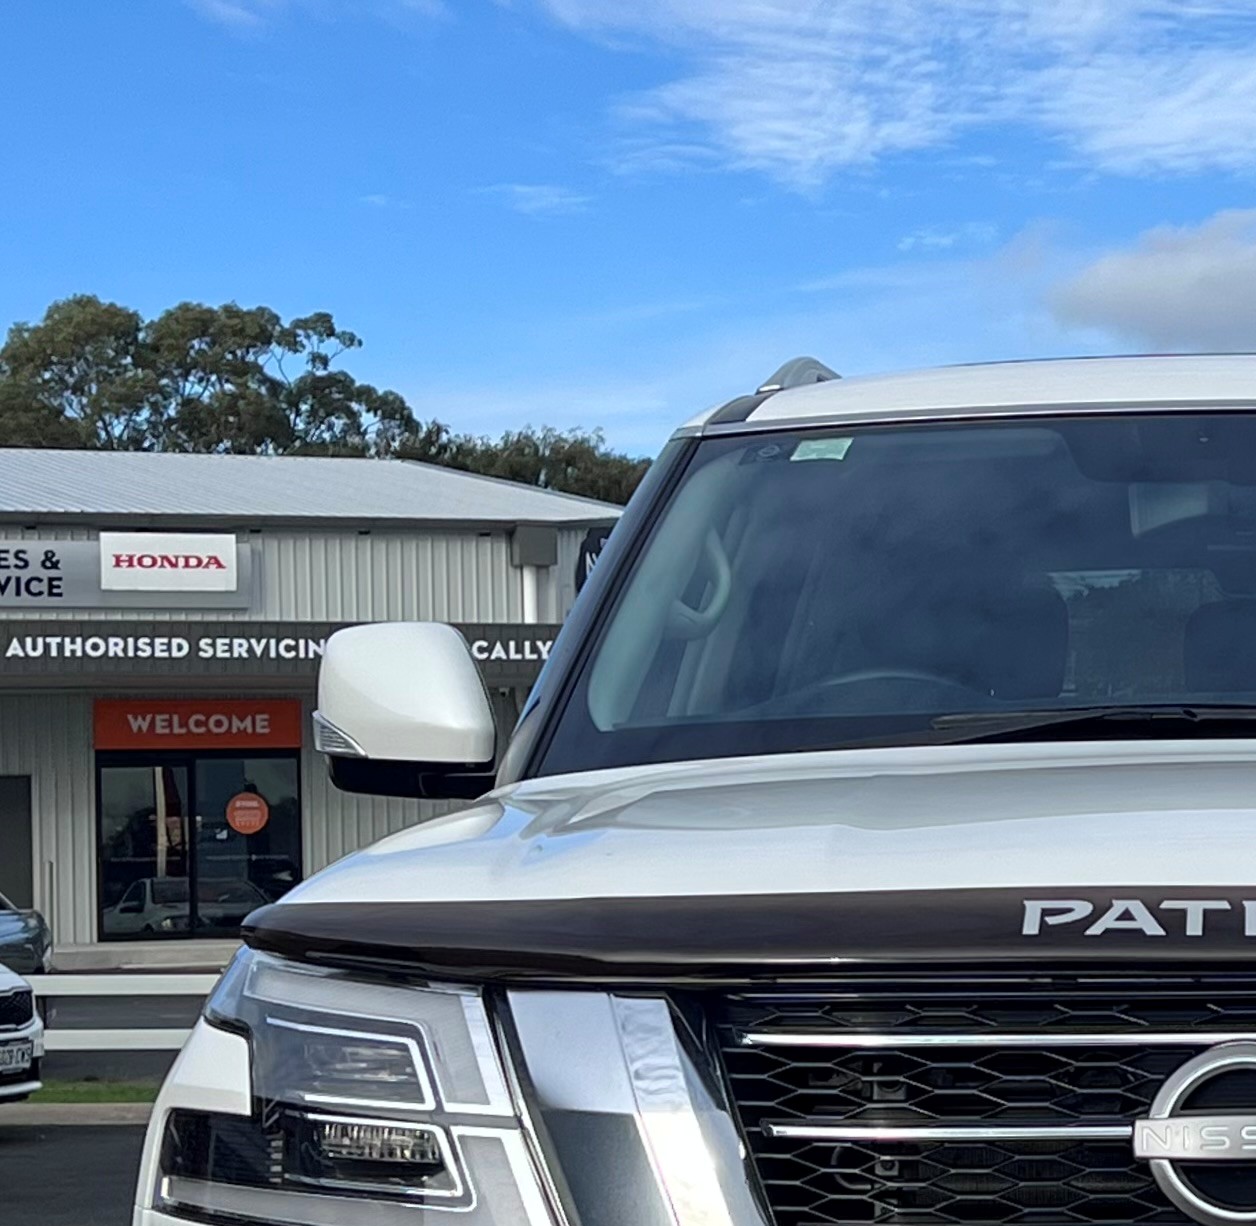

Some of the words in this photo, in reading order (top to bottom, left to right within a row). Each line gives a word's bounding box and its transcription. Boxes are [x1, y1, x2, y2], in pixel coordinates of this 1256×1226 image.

[41, 549, 61, 570] &
[112, 554, 226, 569] HONDA
[5, 637, 190, 658] AUTHORISED
[199, 637, 326, 659] SERVICIN
[471, 640, 552, 660] CALLY
[127, 714, 271, 734] WELCOME
